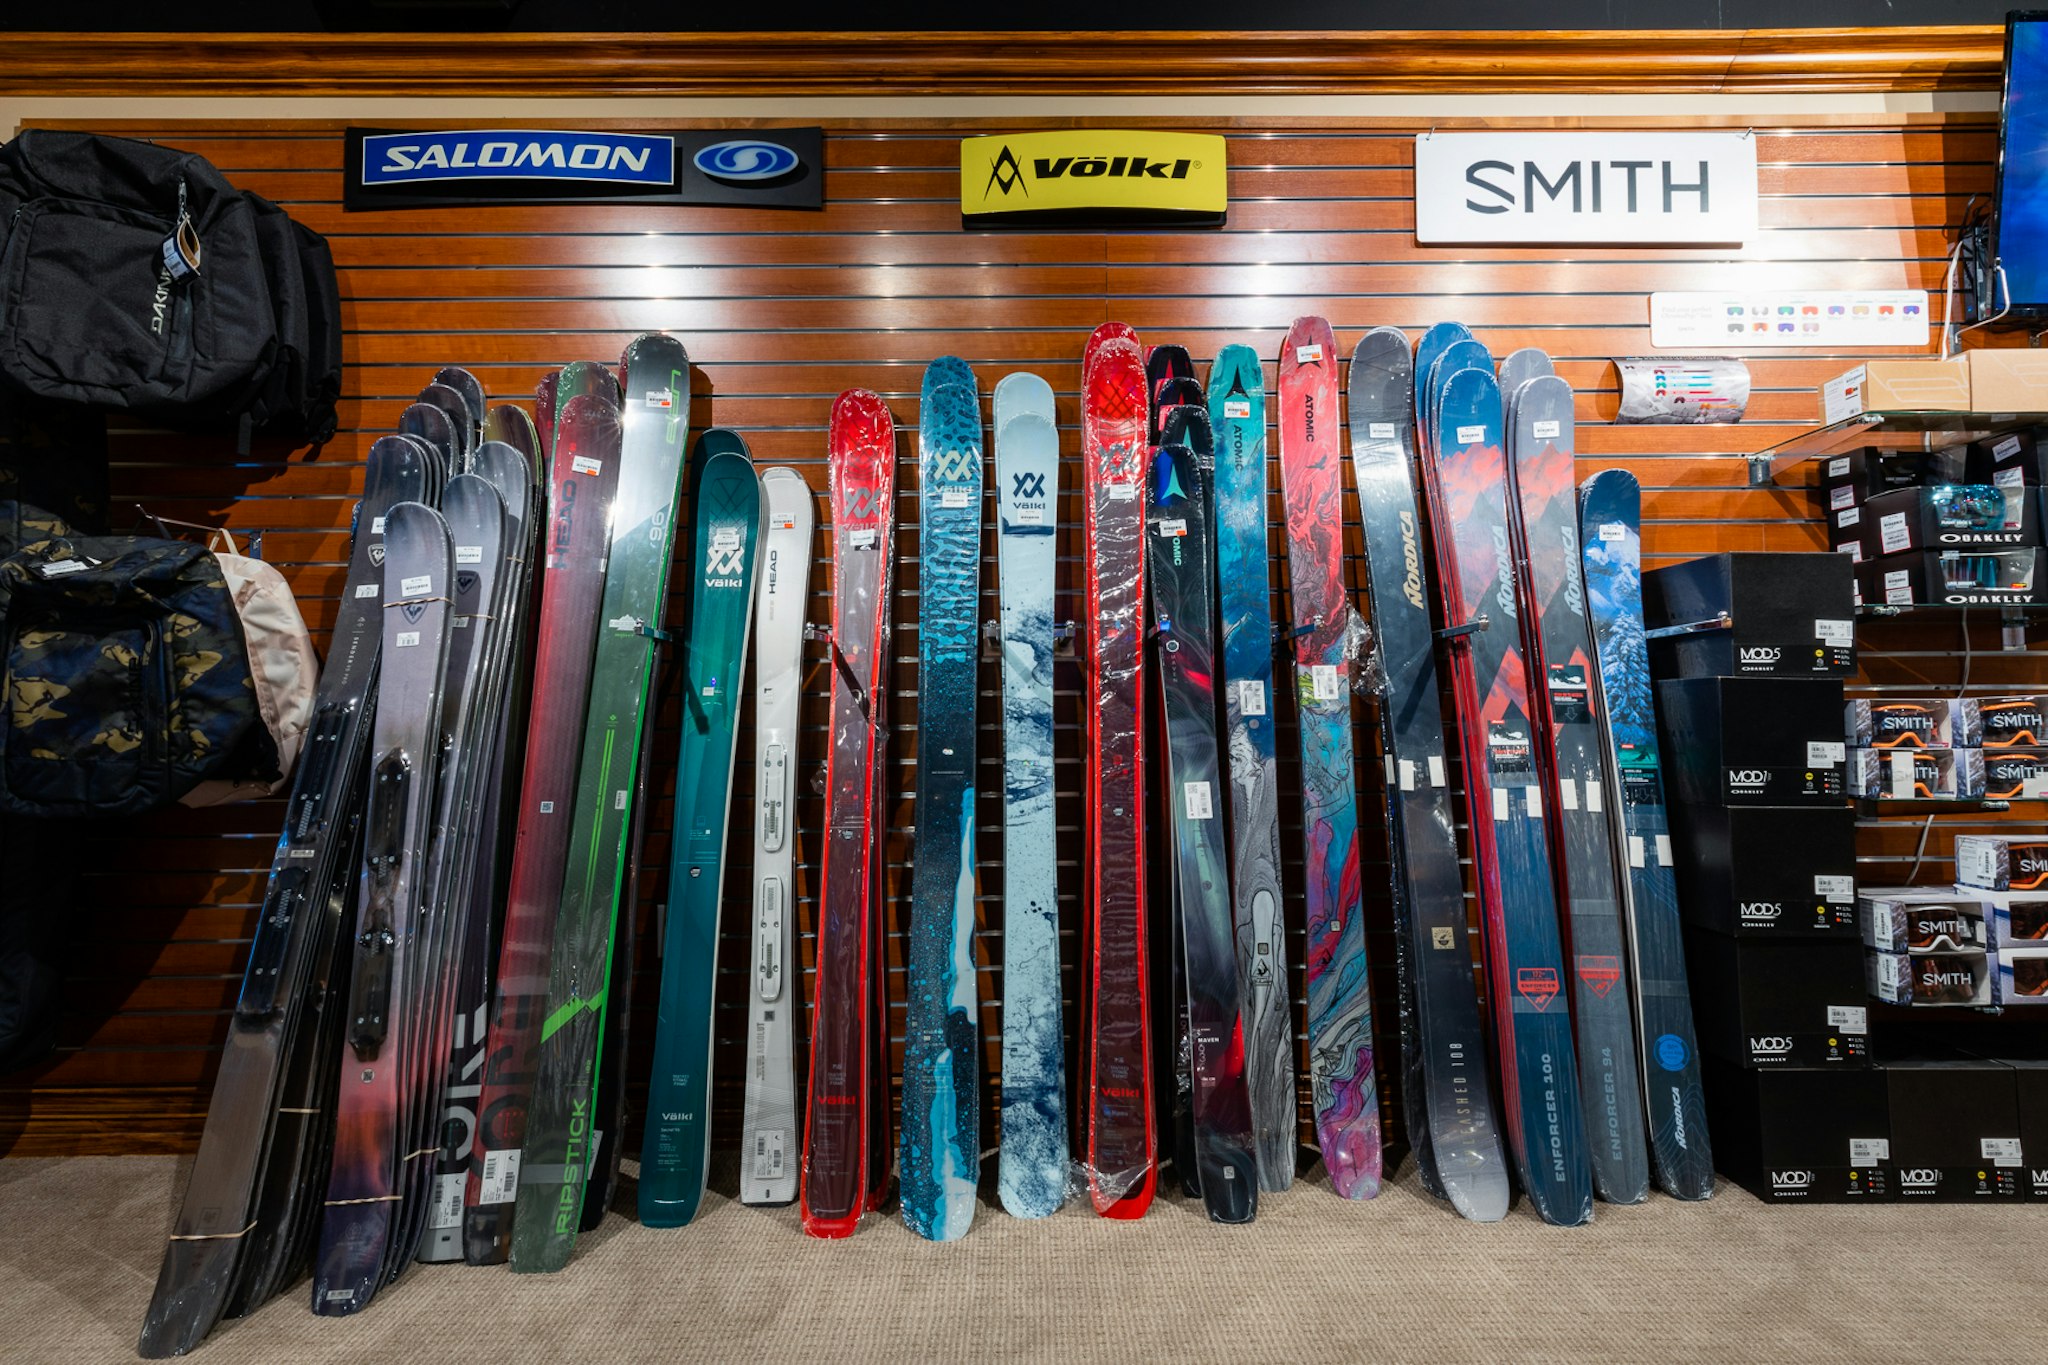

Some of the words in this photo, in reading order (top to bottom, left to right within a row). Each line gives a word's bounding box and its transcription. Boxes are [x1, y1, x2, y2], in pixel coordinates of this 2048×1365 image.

[382, 142, 650, 173] SALOMON
[1034, 157, 1191, 179] Völkl
[1466, 160, 1709, 214] SMITH
[1305, 394, 1315, 442] ATOMIC
[1233, 424, 1243, 472] ATOMIC
[553, 480, 577, 570] HEAD
[1962, 534, 2023, 543] OAKLEY
[1173, 537, 1182, 566] OMIC
[1400, 511, 1424, 609] NORDICA
[705, 578, 742, 588] Völkl
[769, 550, 777, 594] HEAD
[1492, 526, 1517, 619] NORDICA
[1564, 526, 1583, 616] NORDICA
[1968, 595, 2034, 603] OAKLEY
[1884, 716, 1934, 729] SMITH
[1993, 714, 2043, 728] SMITH
[2020, 860, 2048, 872] SMI
[1919, 921, 1967, 934] SMITH
[1923, 973, 1972, 985] SMITH
[1449, 1043, 1465, 1067] 108
[1541, 1053, 1553, 1084] 100
[1101, 1088, 1139, 1097] Völkl
[662, 1113, 693, 1121] Völkl
[1604, 1072, 1623, 1161] ENFORCER
[1671, 1086, 1688, 1149] NORDICA
[1545, 1085, 1566, 1183] ENFORCER
[556, 1098, 588, 1235] RIPSTICK
